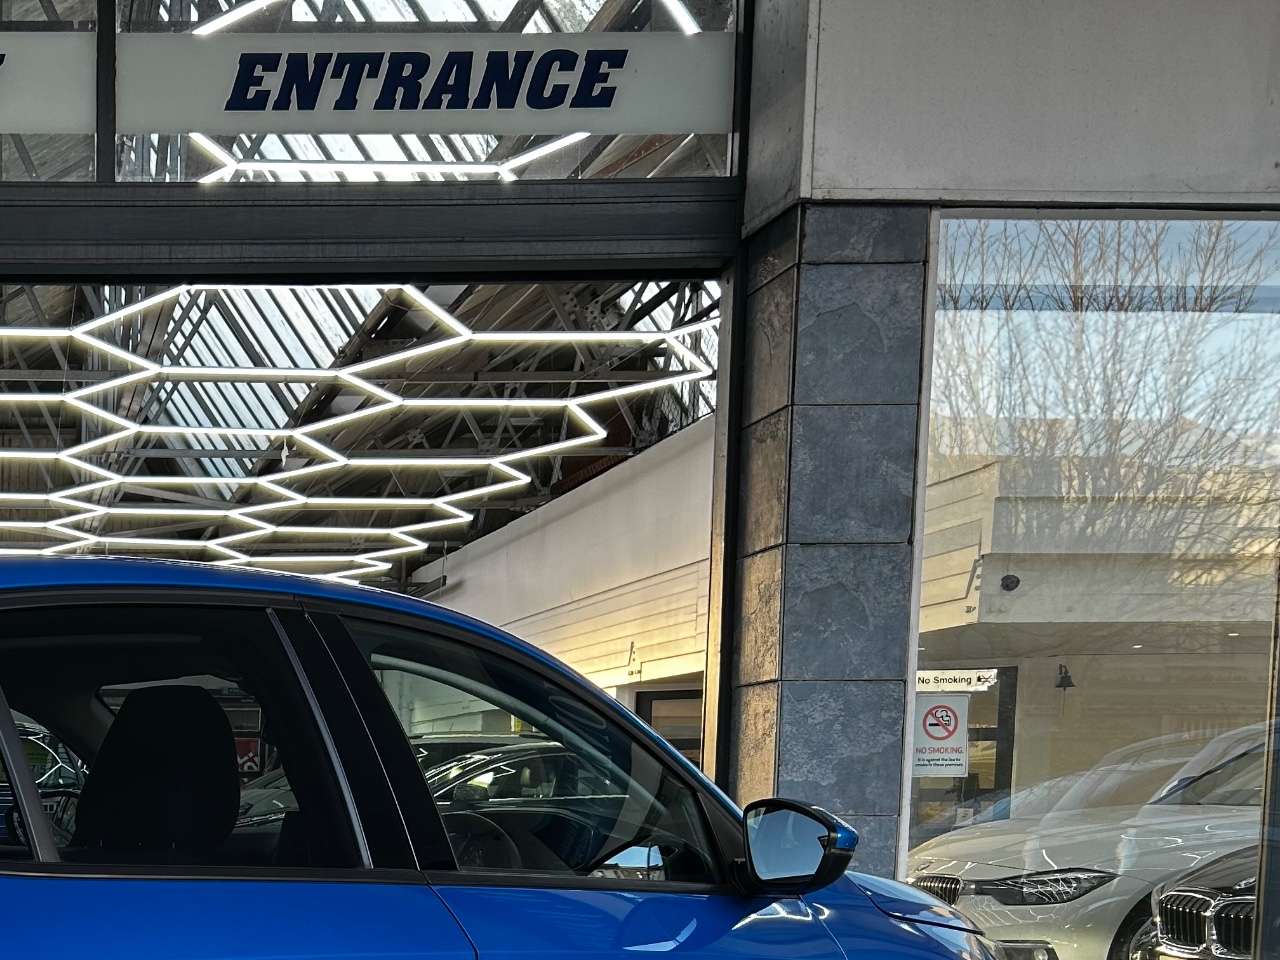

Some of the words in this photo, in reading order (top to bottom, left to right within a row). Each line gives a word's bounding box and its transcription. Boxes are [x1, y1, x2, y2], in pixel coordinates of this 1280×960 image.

[224, 48, 629, 112] ENTRANCE
[917, 676, 931, 685] No
[933, 676, 972, 686] Smoking
[916, 746, 926, 754] NO
